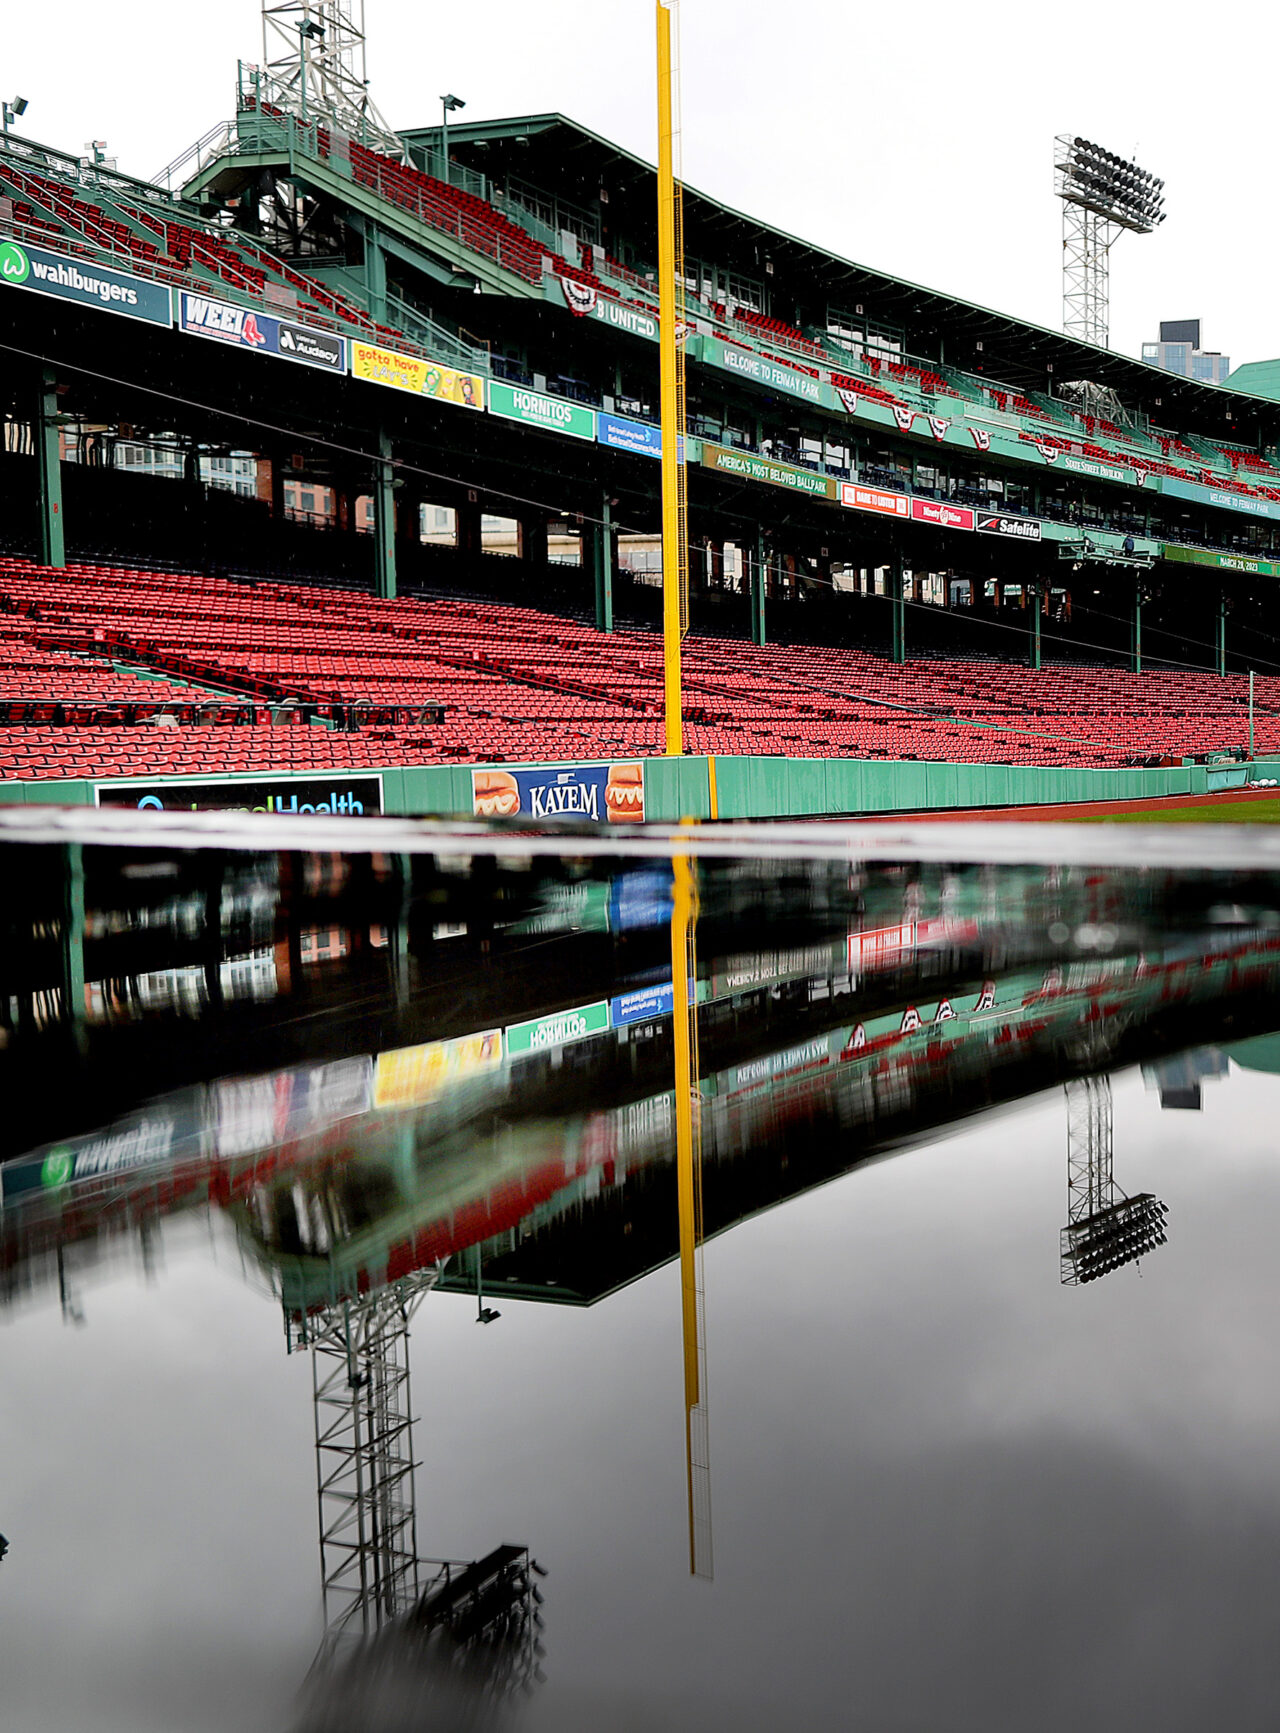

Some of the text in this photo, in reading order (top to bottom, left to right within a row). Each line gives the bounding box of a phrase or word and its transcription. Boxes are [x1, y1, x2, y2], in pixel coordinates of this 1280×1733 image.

[31, 260, 138, 305] wahlburgers
[186, 296, 245, 335] WEEI
[610, 305, 655, 336] UNITED
[297, 343, 338, 364] Audacy
[358, 349, 420, 372] gotta have
[724, 350, 819, 399] WELCOME TO FENWAY PARK
[513, 391, 572, 423] HORNITOS
[717, 454, 826, 493] AMERICA'S MOST BELOVED BALLPARK
[1100, 465, 1123, 480] PAVILION
[1210, 492, 1231, 505] WELCOME
[1257, 503, 1269, 513] PARK
[1000, 519, 1039, 537] Safelite
[1220, 557, 1236, 568] MARCH
[1246, 562, 1258, 571] 2023
[529, 783, 599, 821] KAYEM
